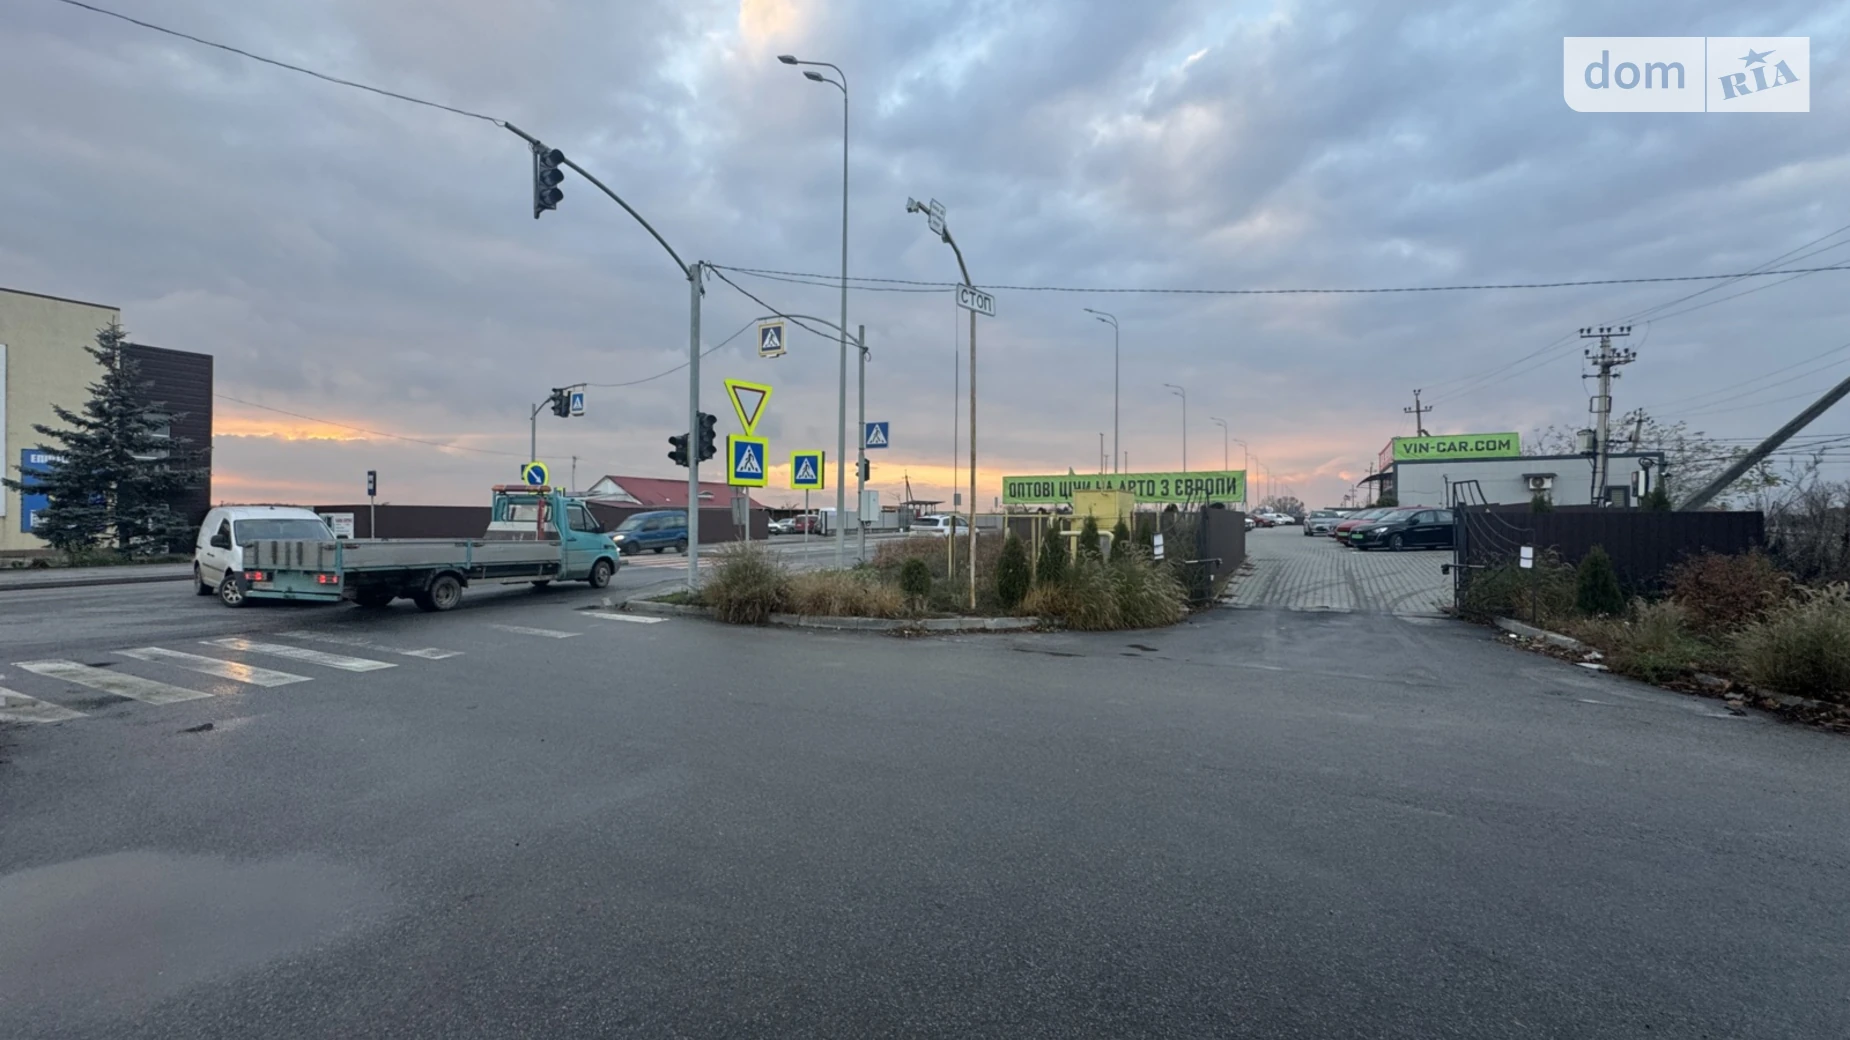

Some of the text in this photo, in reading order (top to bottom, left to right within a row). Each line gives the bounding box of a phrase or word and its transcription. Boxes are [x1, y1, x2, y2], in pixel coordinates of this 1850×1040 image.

[961, 288, 992, 312] СТОП
[1403, 439, 1511, 454] VIN-CAR.COM
[1009, 482, 1054, 498] ОПТОВІ
[1175, 477, 1236, 496] ЄВРОПИ
